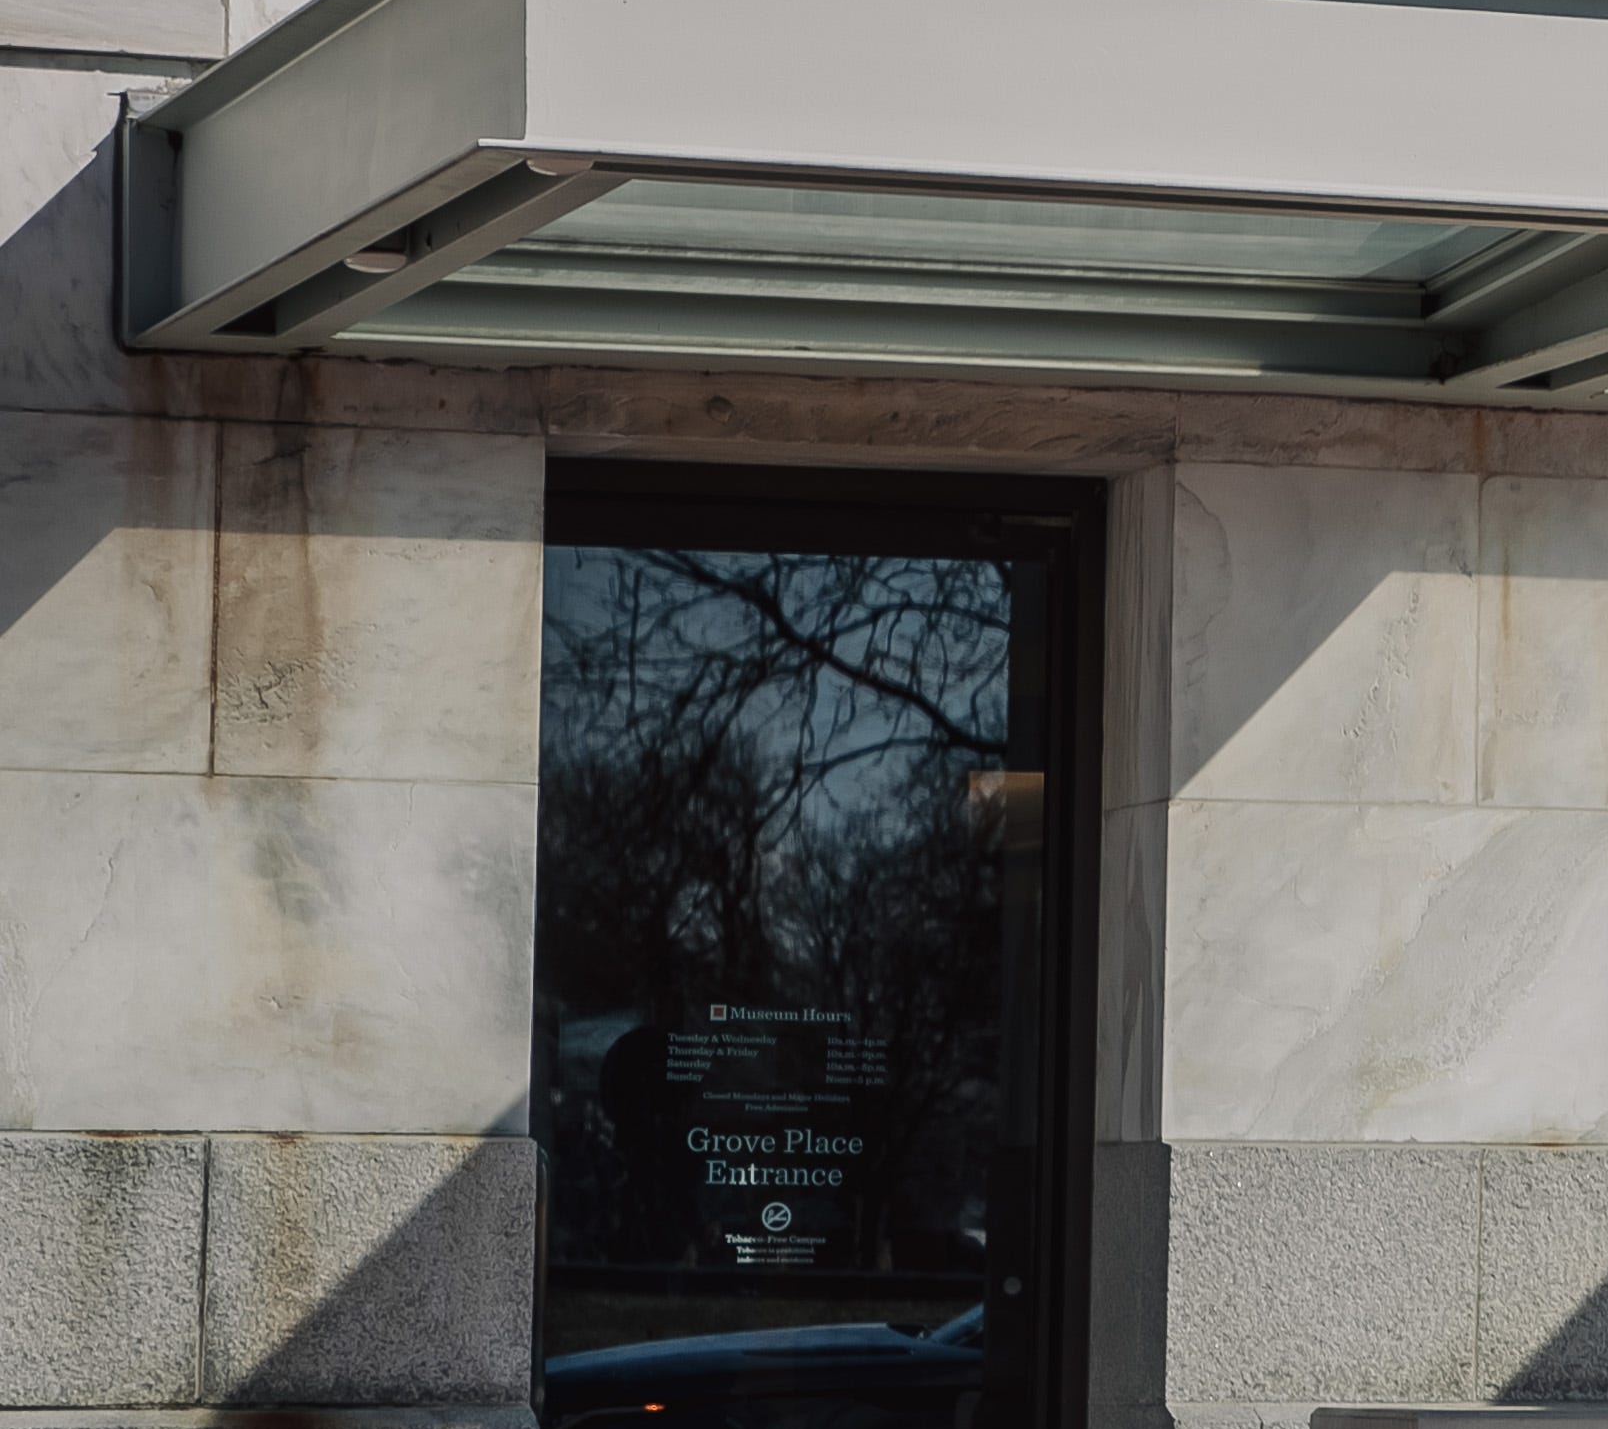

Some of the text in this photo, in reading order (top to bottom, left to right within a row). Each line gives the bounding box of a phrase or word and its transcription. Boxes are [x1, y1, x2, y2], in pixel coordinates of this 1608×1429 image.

[730, 1007, 852, 1023] Museum Hours
[668, 1033, 709, 1045] Tuesday
[721, 1034, 777, 1046] Wednesday
[668, 1046, 713, 1058] Thursday
[727, 1047, 760, 1058] Friday
[667, 1059, 712, 1071] Saturday
[667, 1072, 704, 1083] Sunday
[686, 1126, 864, 1155] Grove Place
[704, 1159, 844, 1187] Entrance
